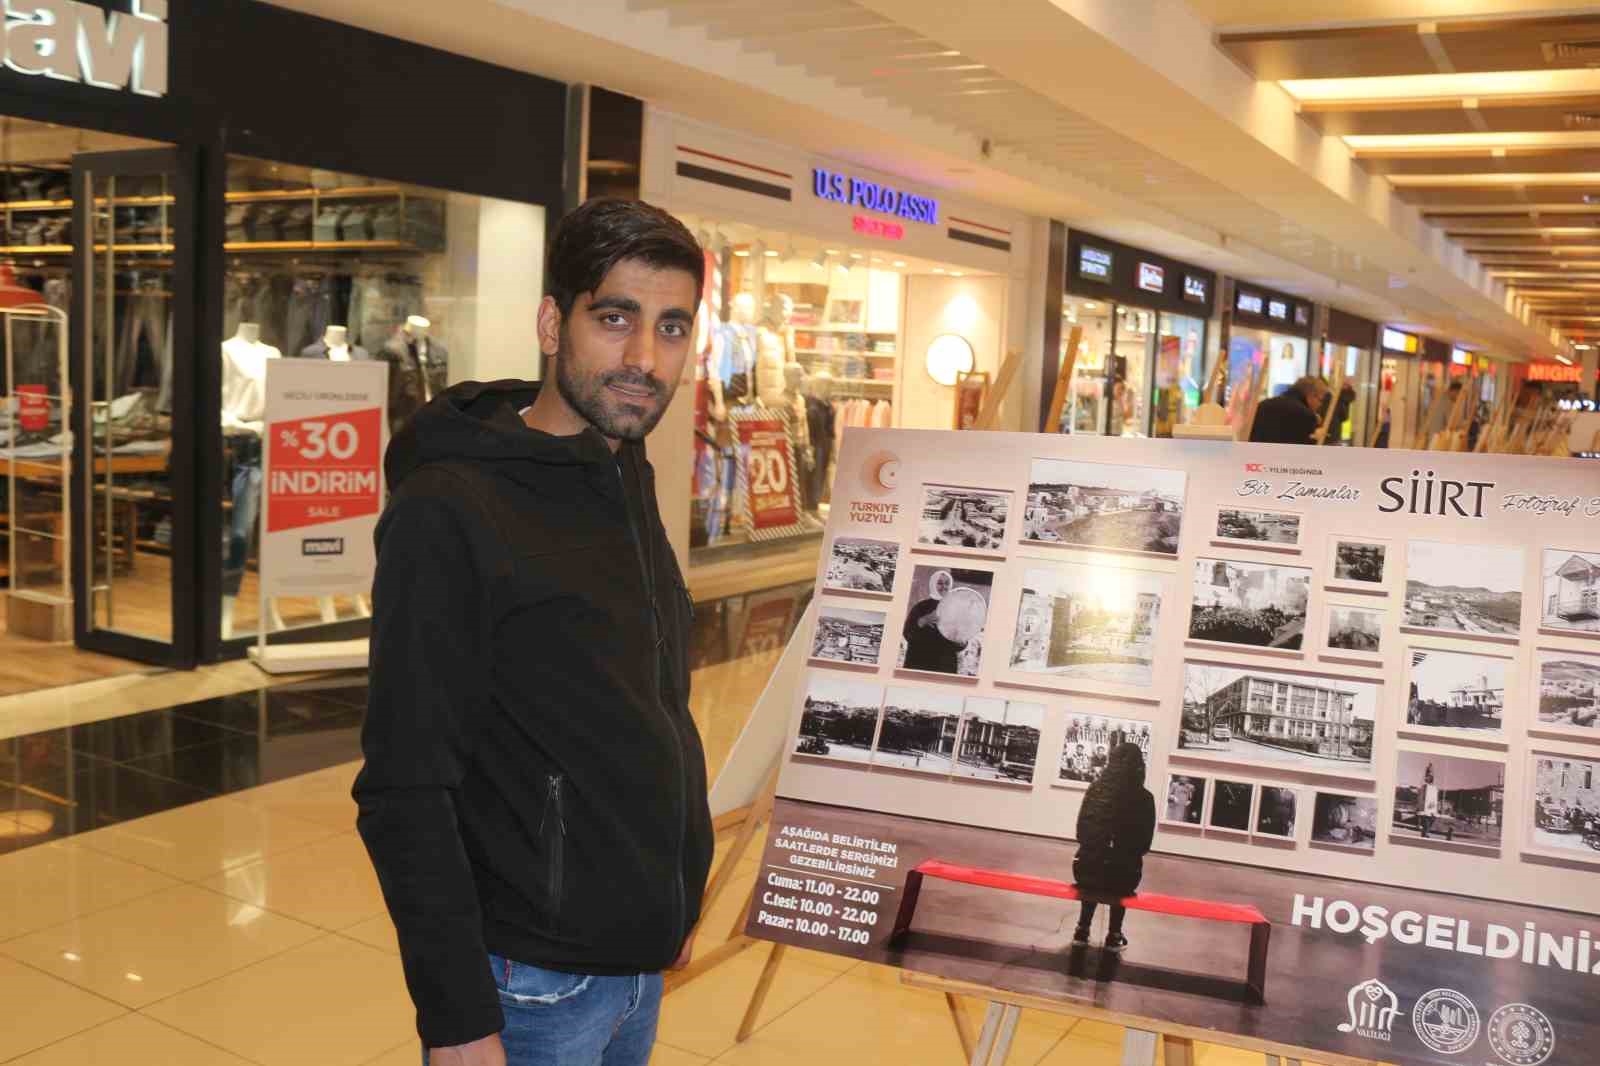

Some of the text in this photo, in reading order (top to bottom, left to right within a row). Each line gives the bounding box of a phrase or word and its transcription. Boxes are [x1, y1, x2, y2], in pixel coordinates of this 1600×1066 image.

[0, 0, 168, 98] avi
[849, 176, 897, 214] POLO
[271, 468, 376, 495] İNDİRİM
[1236, 479, 1270, 496] Bir
[1276, 481, 1360, 500] Zamanlar
[307, 506, 341, 518] SALE
[775, 838, 898, 868] SAATLERDE SERGİMİZİ
[780, 826, 897, 854] AŞAĞIDA BELİRTİLEN
[789, 854, 877, 879] GEZEBİLİRSİNİZ
[767, 872, 803, 890] Cuma:
[805, 879, 835, 897] 11.00
[843, 887, 880, 905] 22.00
[762, 892, 797, 910] C.tesi:
[800, 897, 834, 917] 10.00
[841, 906, 878, 926] 22.00
[757, 910, 793, 930] Pazar:
[795, 917, 829, 937] 10.00
[837, 926, 870, 945] 17.00
